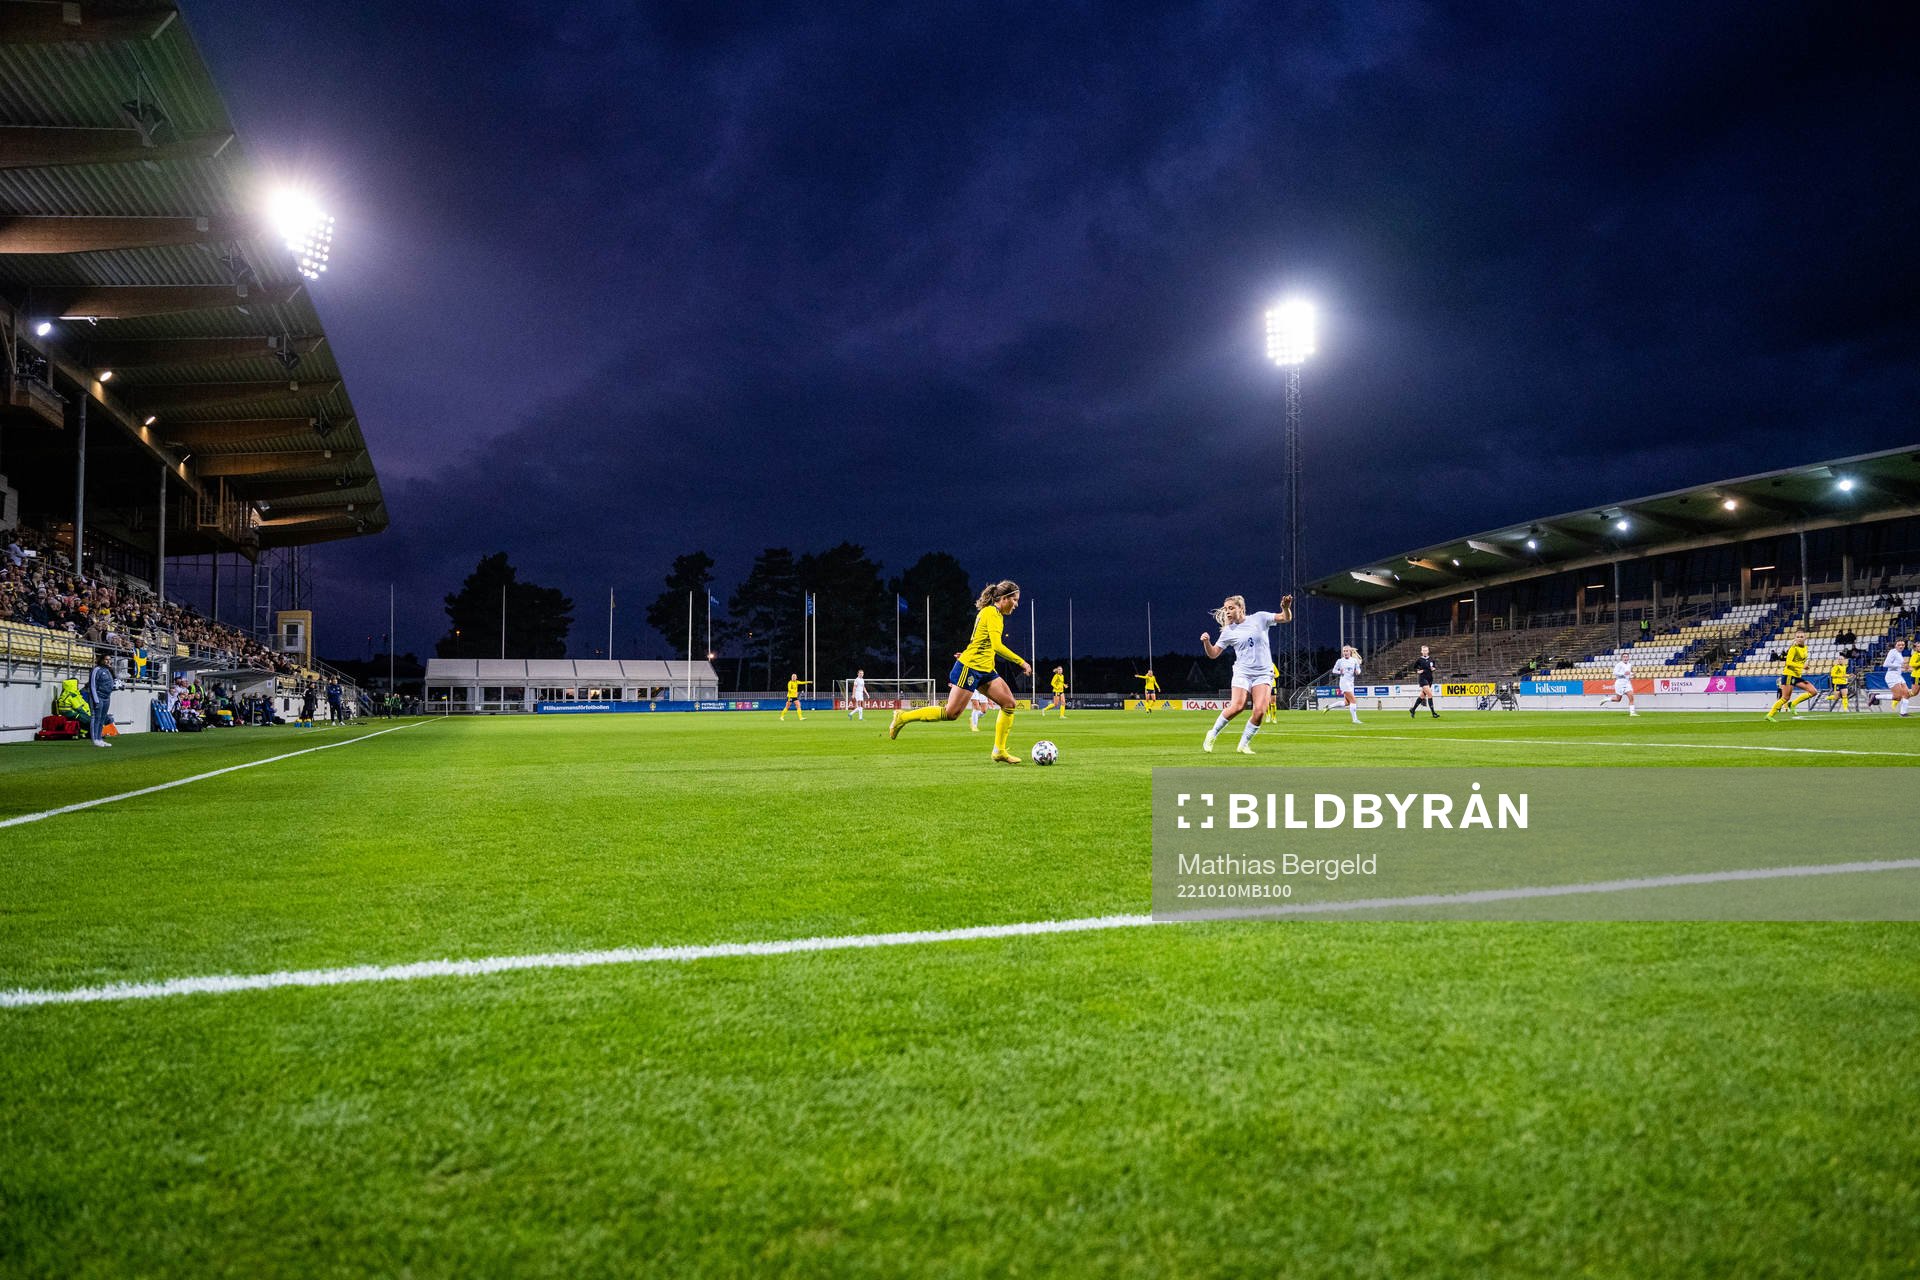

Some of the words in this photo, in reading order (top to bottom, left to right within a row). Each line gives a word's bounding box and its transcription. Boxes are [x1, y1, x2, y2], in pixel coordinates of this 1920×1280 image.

[1248, 637, 1254, 648] 3
[1535, 683, 1567, 693] Folksam
[1186, 701, 1200, 709] ICA
